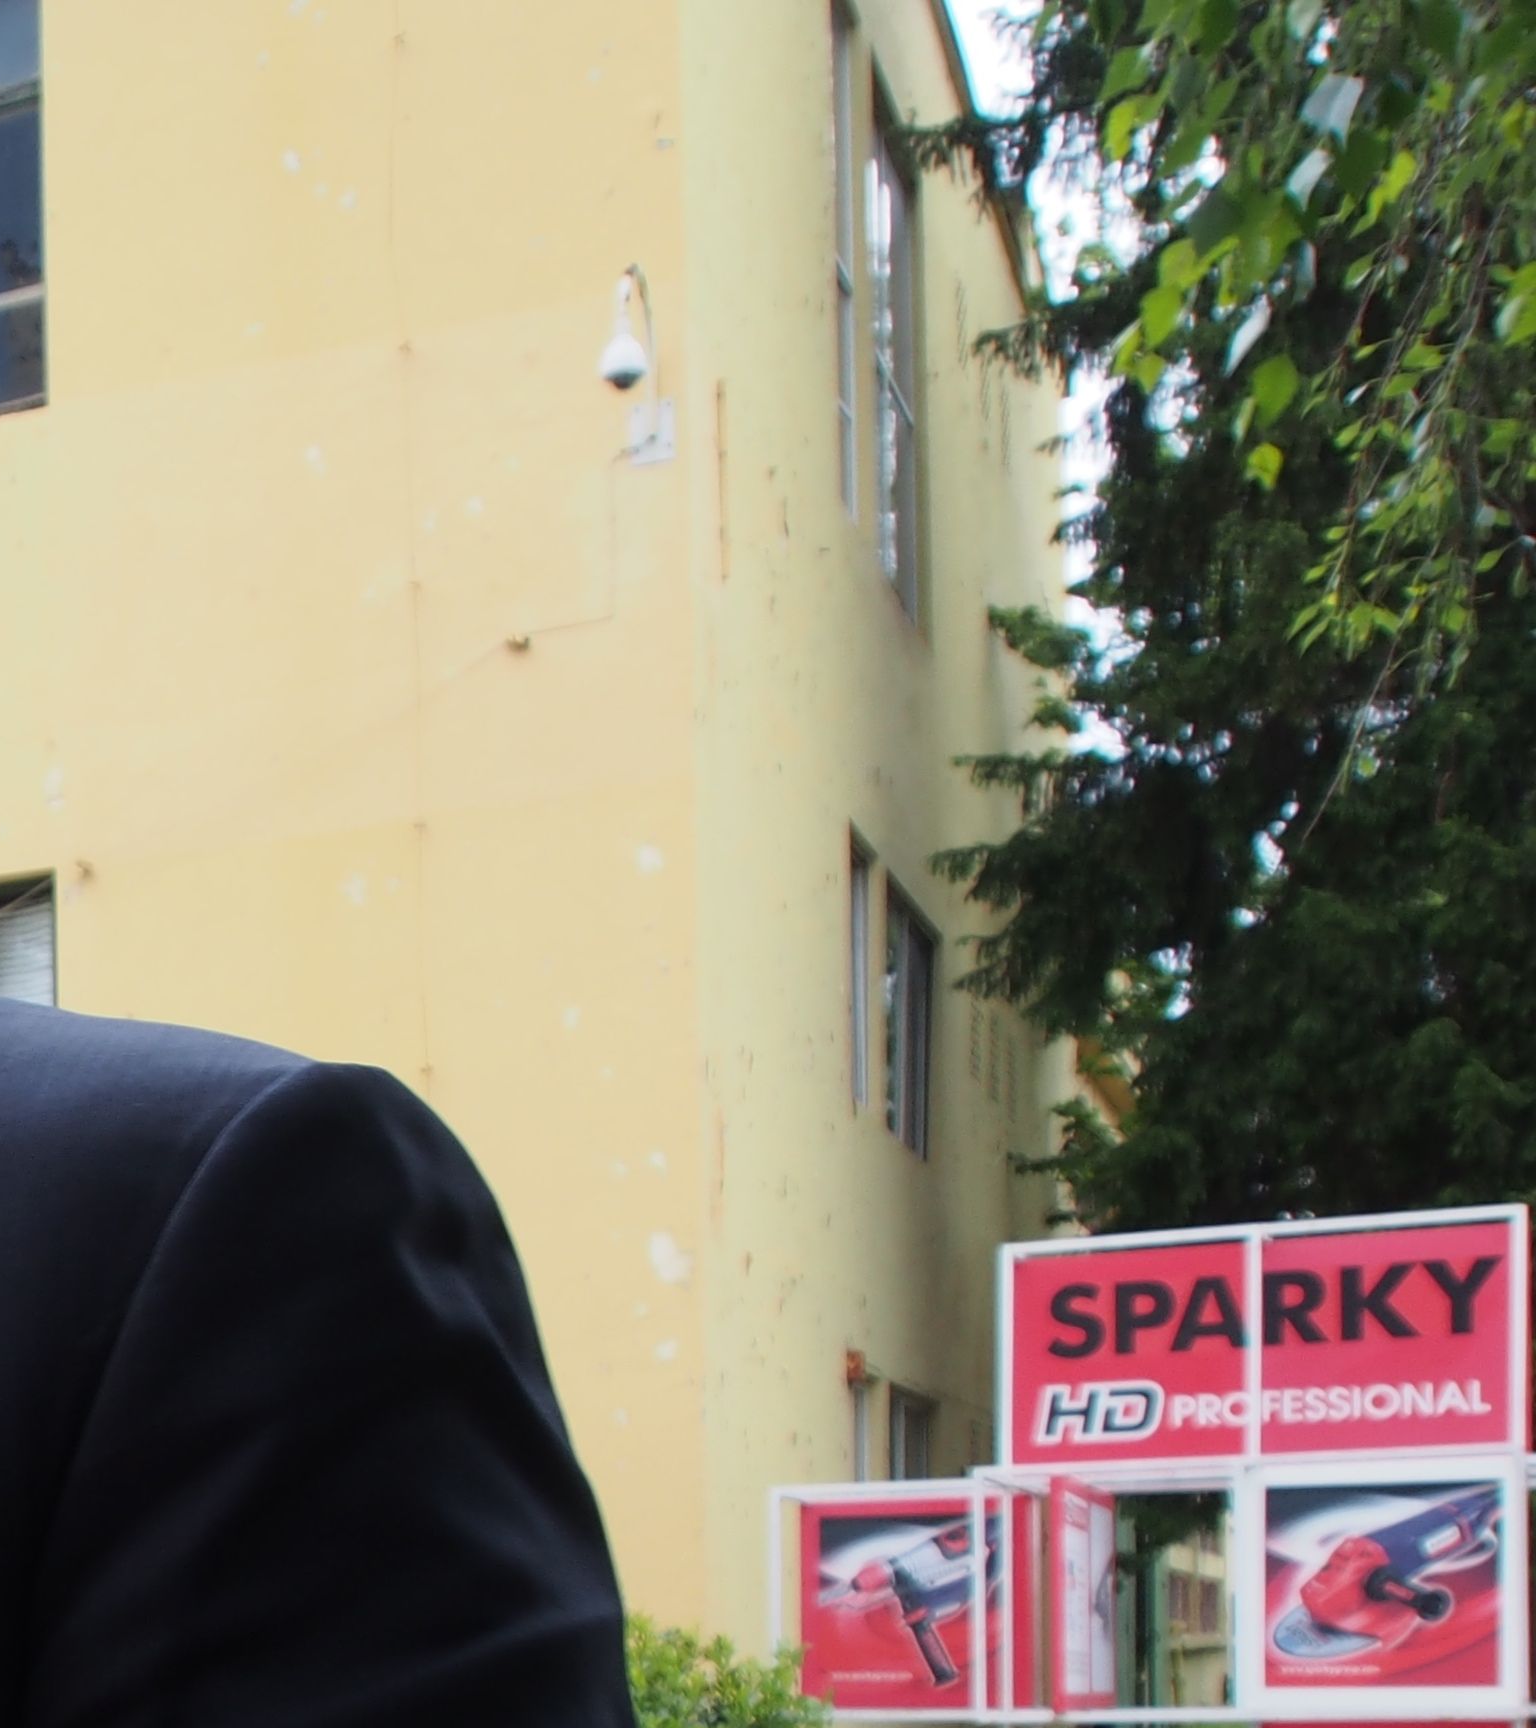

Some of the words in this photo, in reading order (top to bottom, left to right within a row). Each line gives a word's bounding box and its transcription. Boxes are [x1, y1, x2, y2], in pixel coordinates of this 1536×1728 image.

[1047, 1255, 1503, 1360] SPARKY
[1034, 1379, 1164, 1446] HD
[1169, 1379, 1492, 1428] PROFESSIONAL
